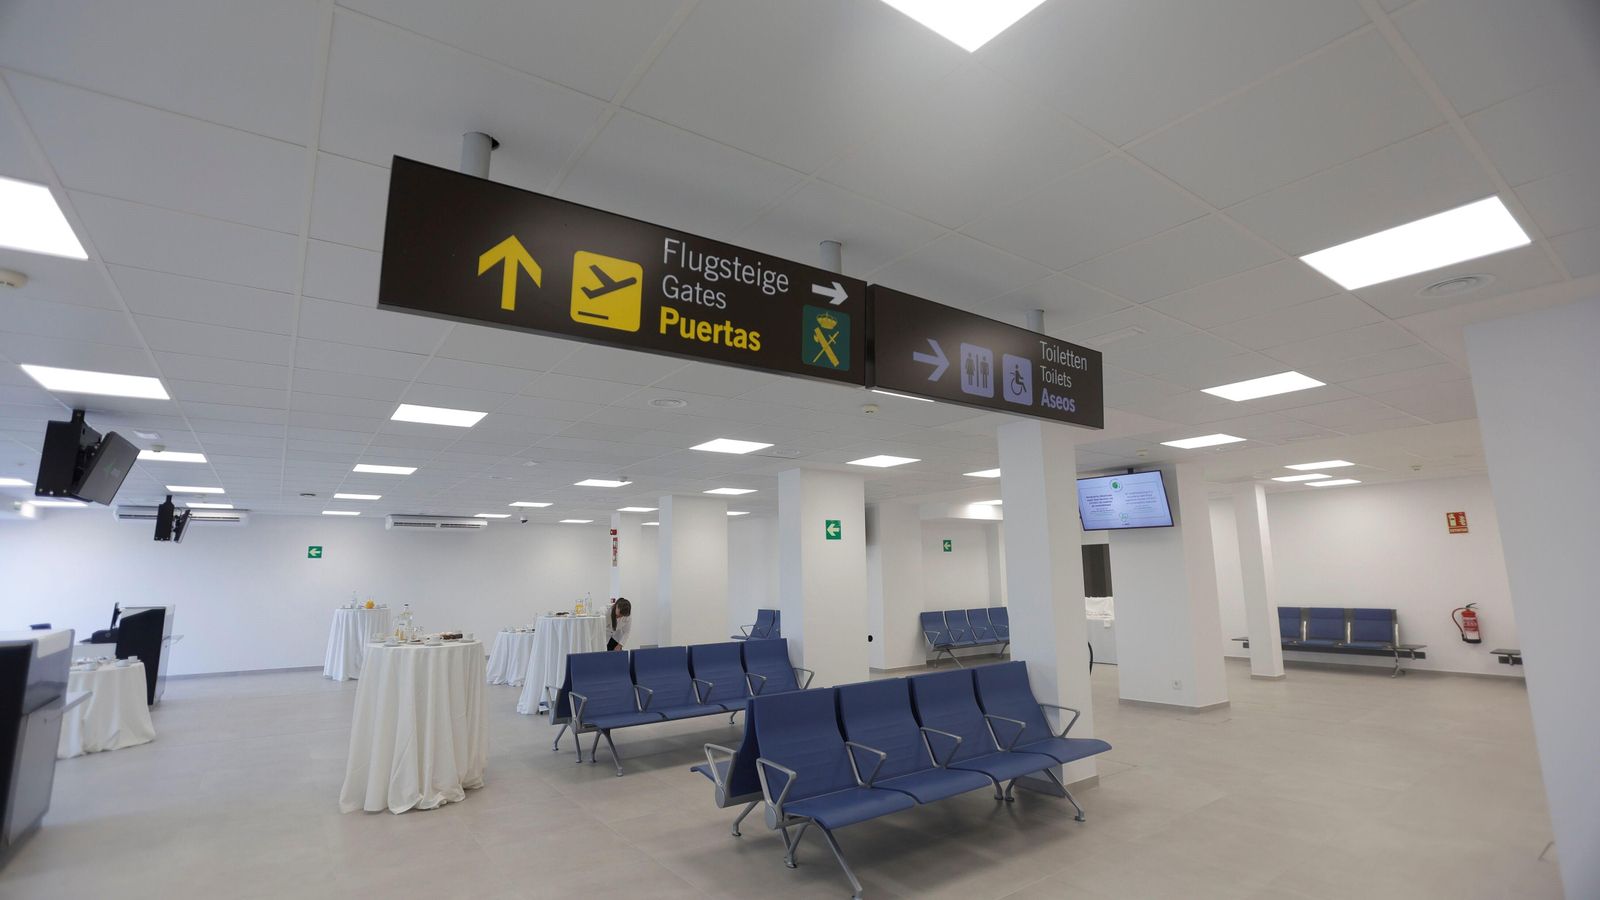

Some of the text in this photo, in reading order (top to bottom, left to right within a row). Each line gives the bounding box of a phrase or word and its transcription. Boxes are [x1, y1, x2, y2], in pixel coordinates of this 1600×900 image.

[664, 237, 789, 295] Flugsteige
[662, 275, 727, 309] Gates
[659, 306, 761, 352] Puertas
[1039, 340, 1088, 371] Toiletten
[1039, 365, 1072, 388] Toilets
[1041, 387, 1076, 413] Aseos
